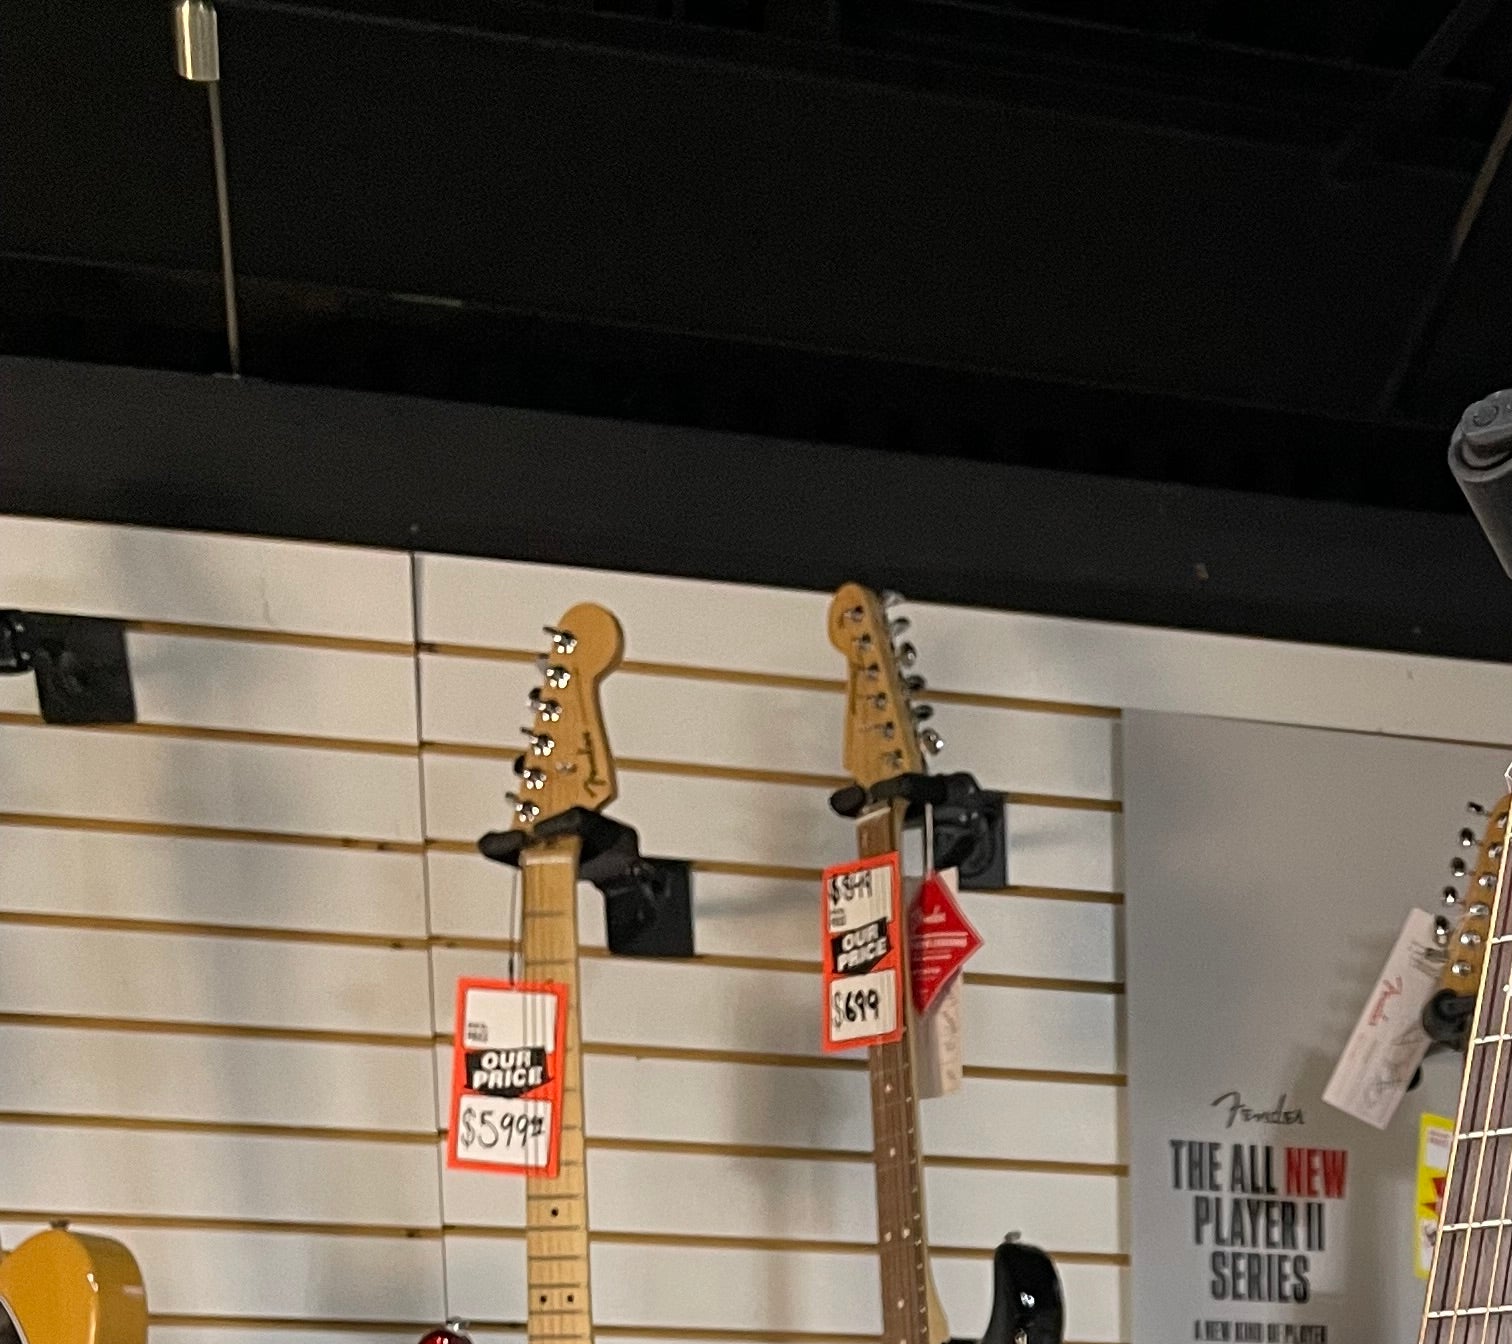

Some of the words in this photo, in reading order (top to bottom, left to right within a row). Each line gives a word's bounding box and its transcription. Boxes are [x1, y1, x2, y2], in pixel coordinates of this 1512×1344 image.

[837, 937, 888, 972] PRICE
[842, 923, 880, 951] OUR
[472, 1066, 544, 1089] PRICE
[480, 1049, 532, 1070] OUR
[1210, 1091, 1305, 1128] Fender
[1169, 1139, 1223, 1192] THE
[1230, 1143, 1279, 1196] ALL
[1285, 1146, 1348, 1199] NEW
[1193, 1195, 1297, 1250] PLAYER
[1306, 1201, 1327, 1251] II
[1210, 1251, 1312, 1304] SERIES
